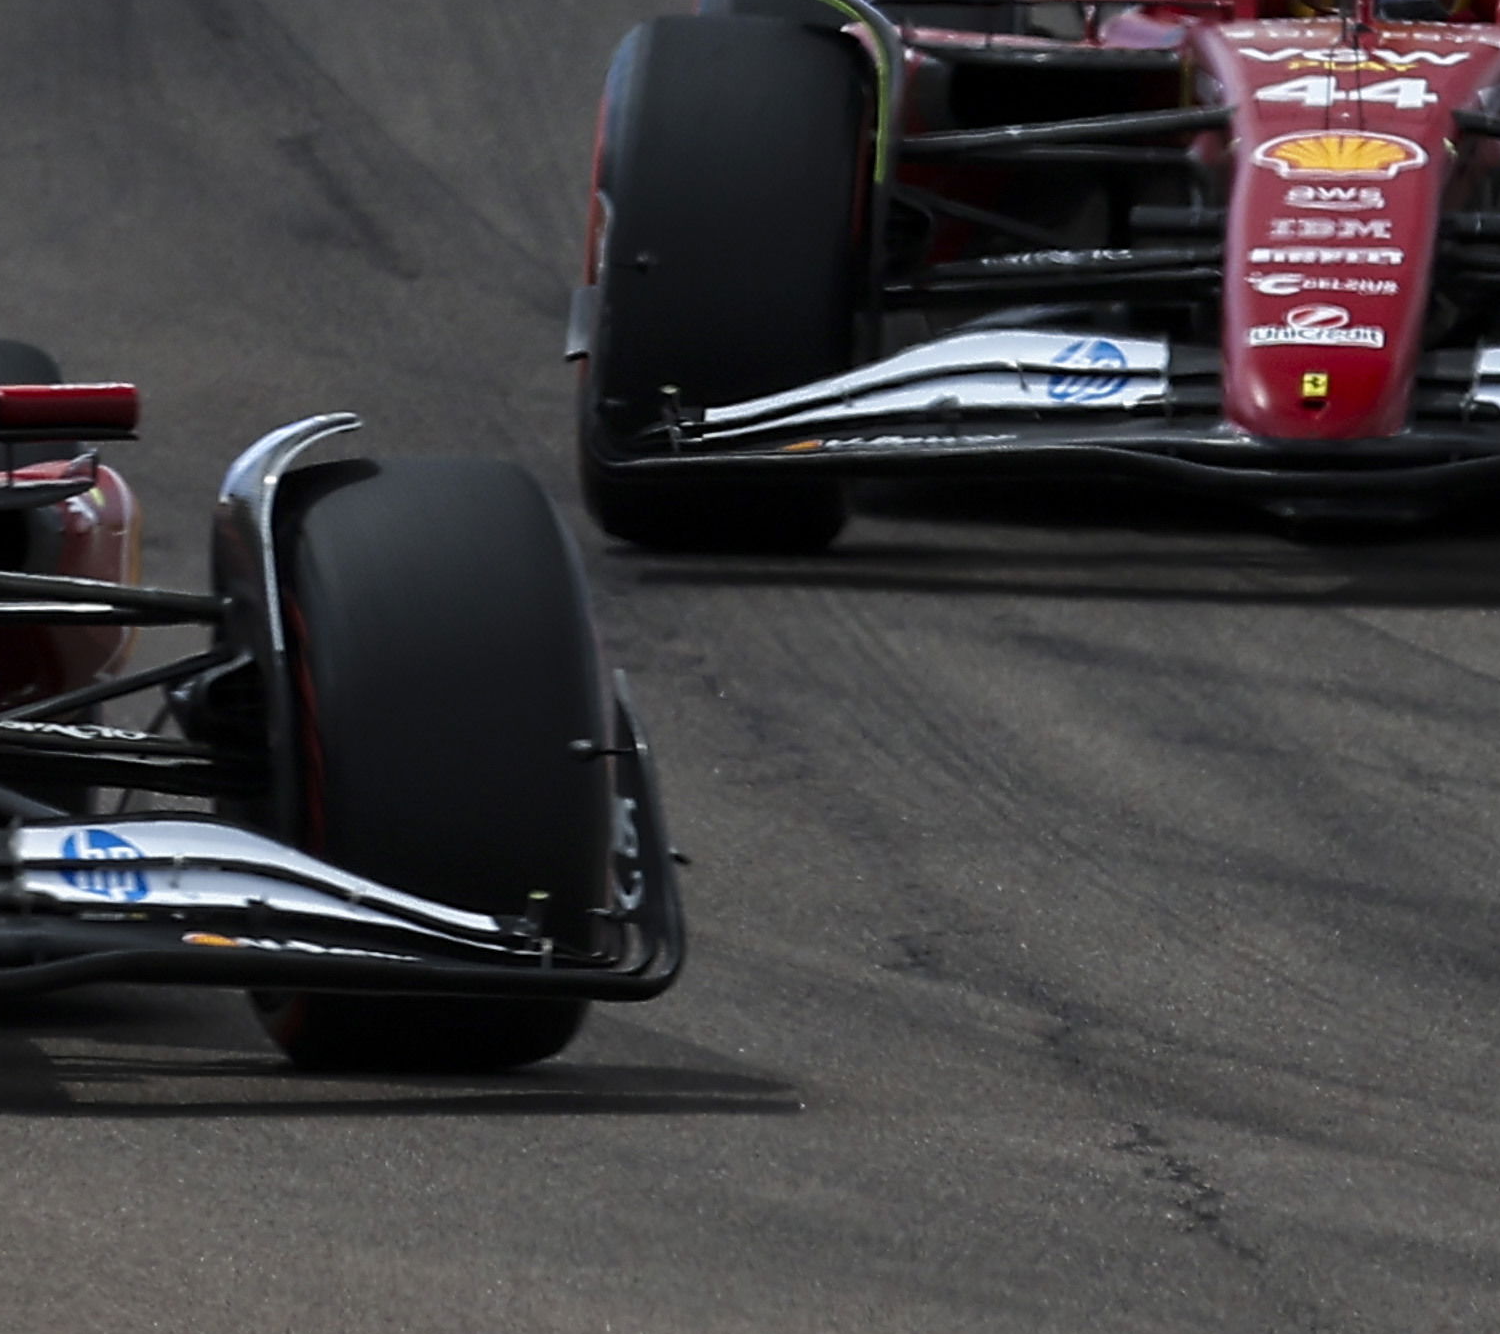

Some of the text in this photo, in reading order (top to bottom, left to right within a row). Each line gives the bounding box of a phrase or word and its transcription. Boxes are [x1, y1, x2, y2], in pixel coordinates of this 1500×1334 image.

[1255, 76, 1438, 108] 44
[1270, 218, 1393, 239] IBM
[74, 829, 136, 901] hp
